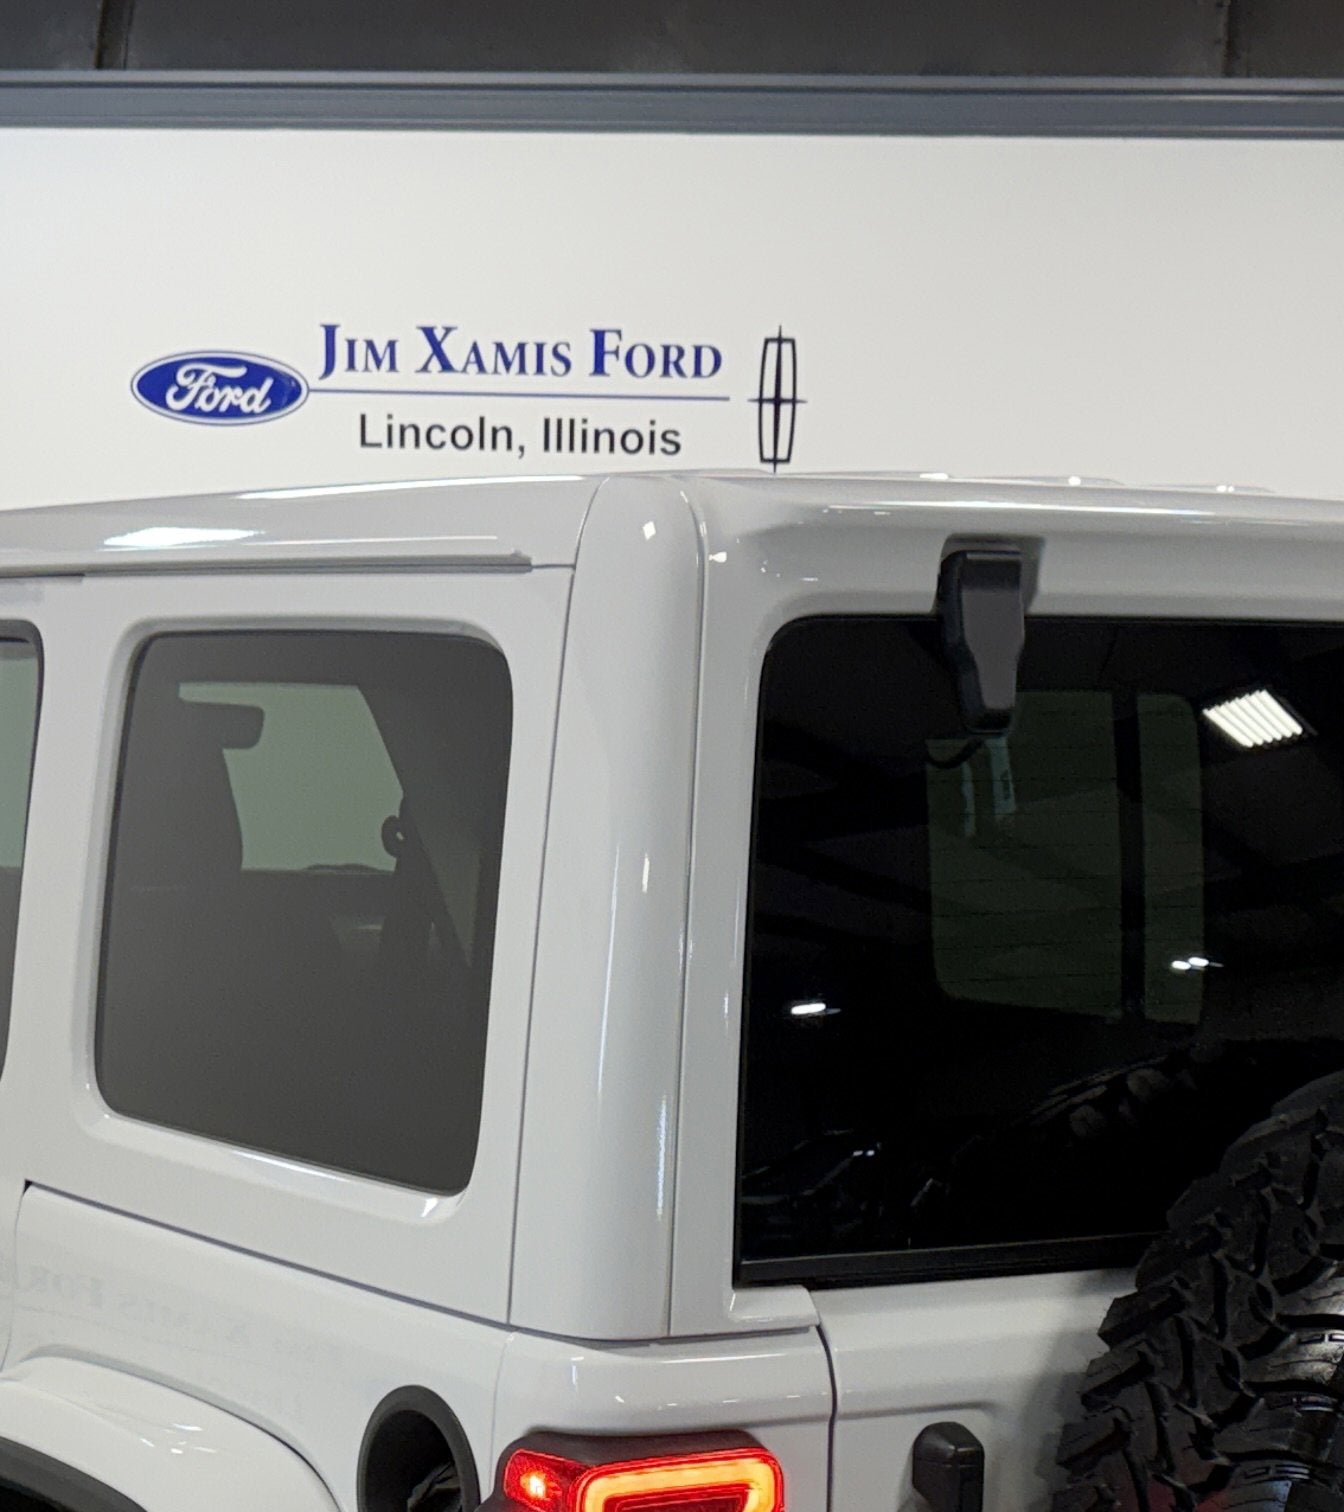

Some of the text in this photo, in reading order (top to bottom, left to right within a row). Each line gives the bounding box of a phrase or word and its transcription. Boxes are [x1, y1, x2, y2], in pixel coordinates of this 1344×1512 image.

[319, 324, 722, 380] JIM XAMIS FORD
[164, 364, 274, 415] Ford
[360, 413, 681, 458] Lincoln, Illinois
